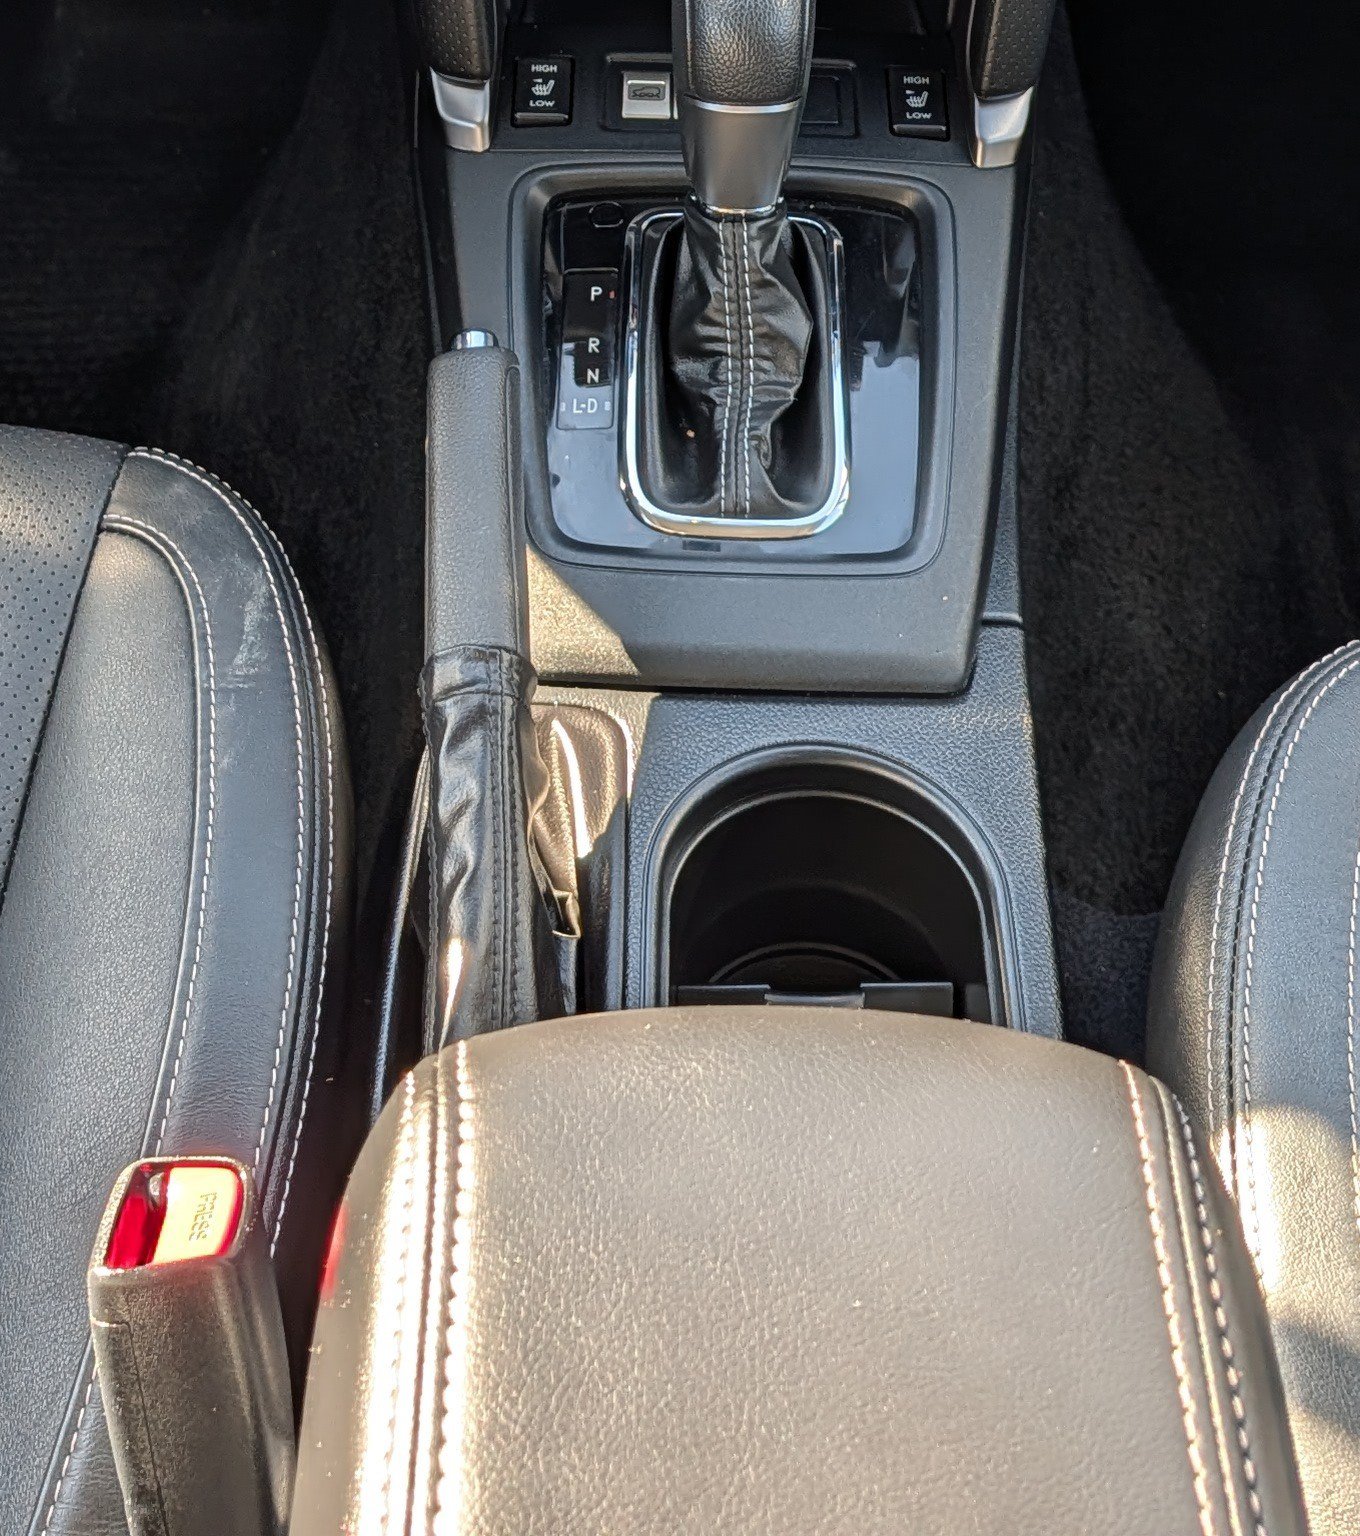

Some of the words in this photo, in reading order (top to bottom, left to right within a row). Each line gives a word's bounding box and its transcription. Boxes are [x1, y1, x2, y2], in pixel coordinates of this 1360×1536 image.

[530, 64, 558, 73] HIGH
[903, 75, 930, 85] HIGH
[529, 99, 556, 107] LOW
[906, 111, 932, 120] LOW
[590, 286, 603, 302] P
[587, 337, 600, 354] R
[586, 368, 600, 384] N
